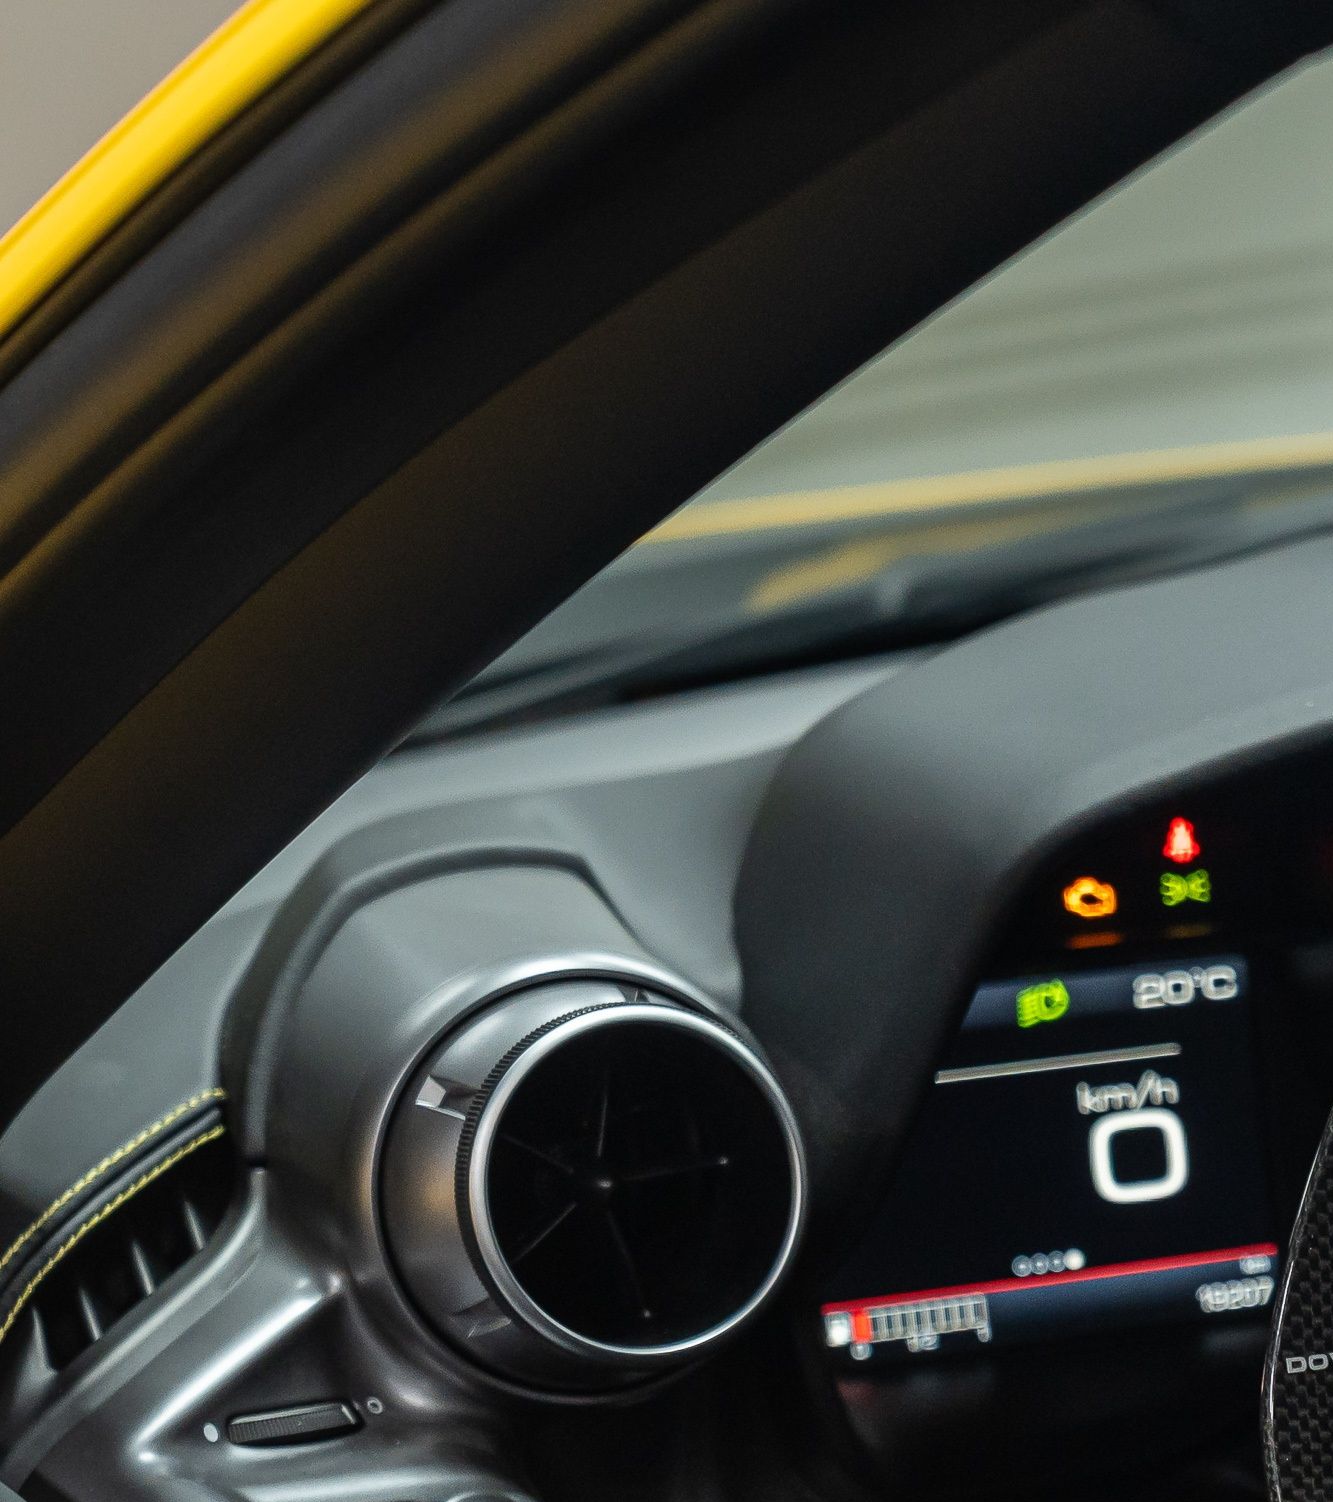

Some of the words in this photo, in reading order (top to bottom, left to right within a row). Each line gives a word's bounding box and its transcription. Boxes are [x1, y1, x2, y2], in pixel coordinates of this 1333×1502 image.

[1133, 965, 1238, 1009] 20°C
[1076, 1069, 1180, 1115] km/h
[1089, 1107, 1189, 1204] 0
